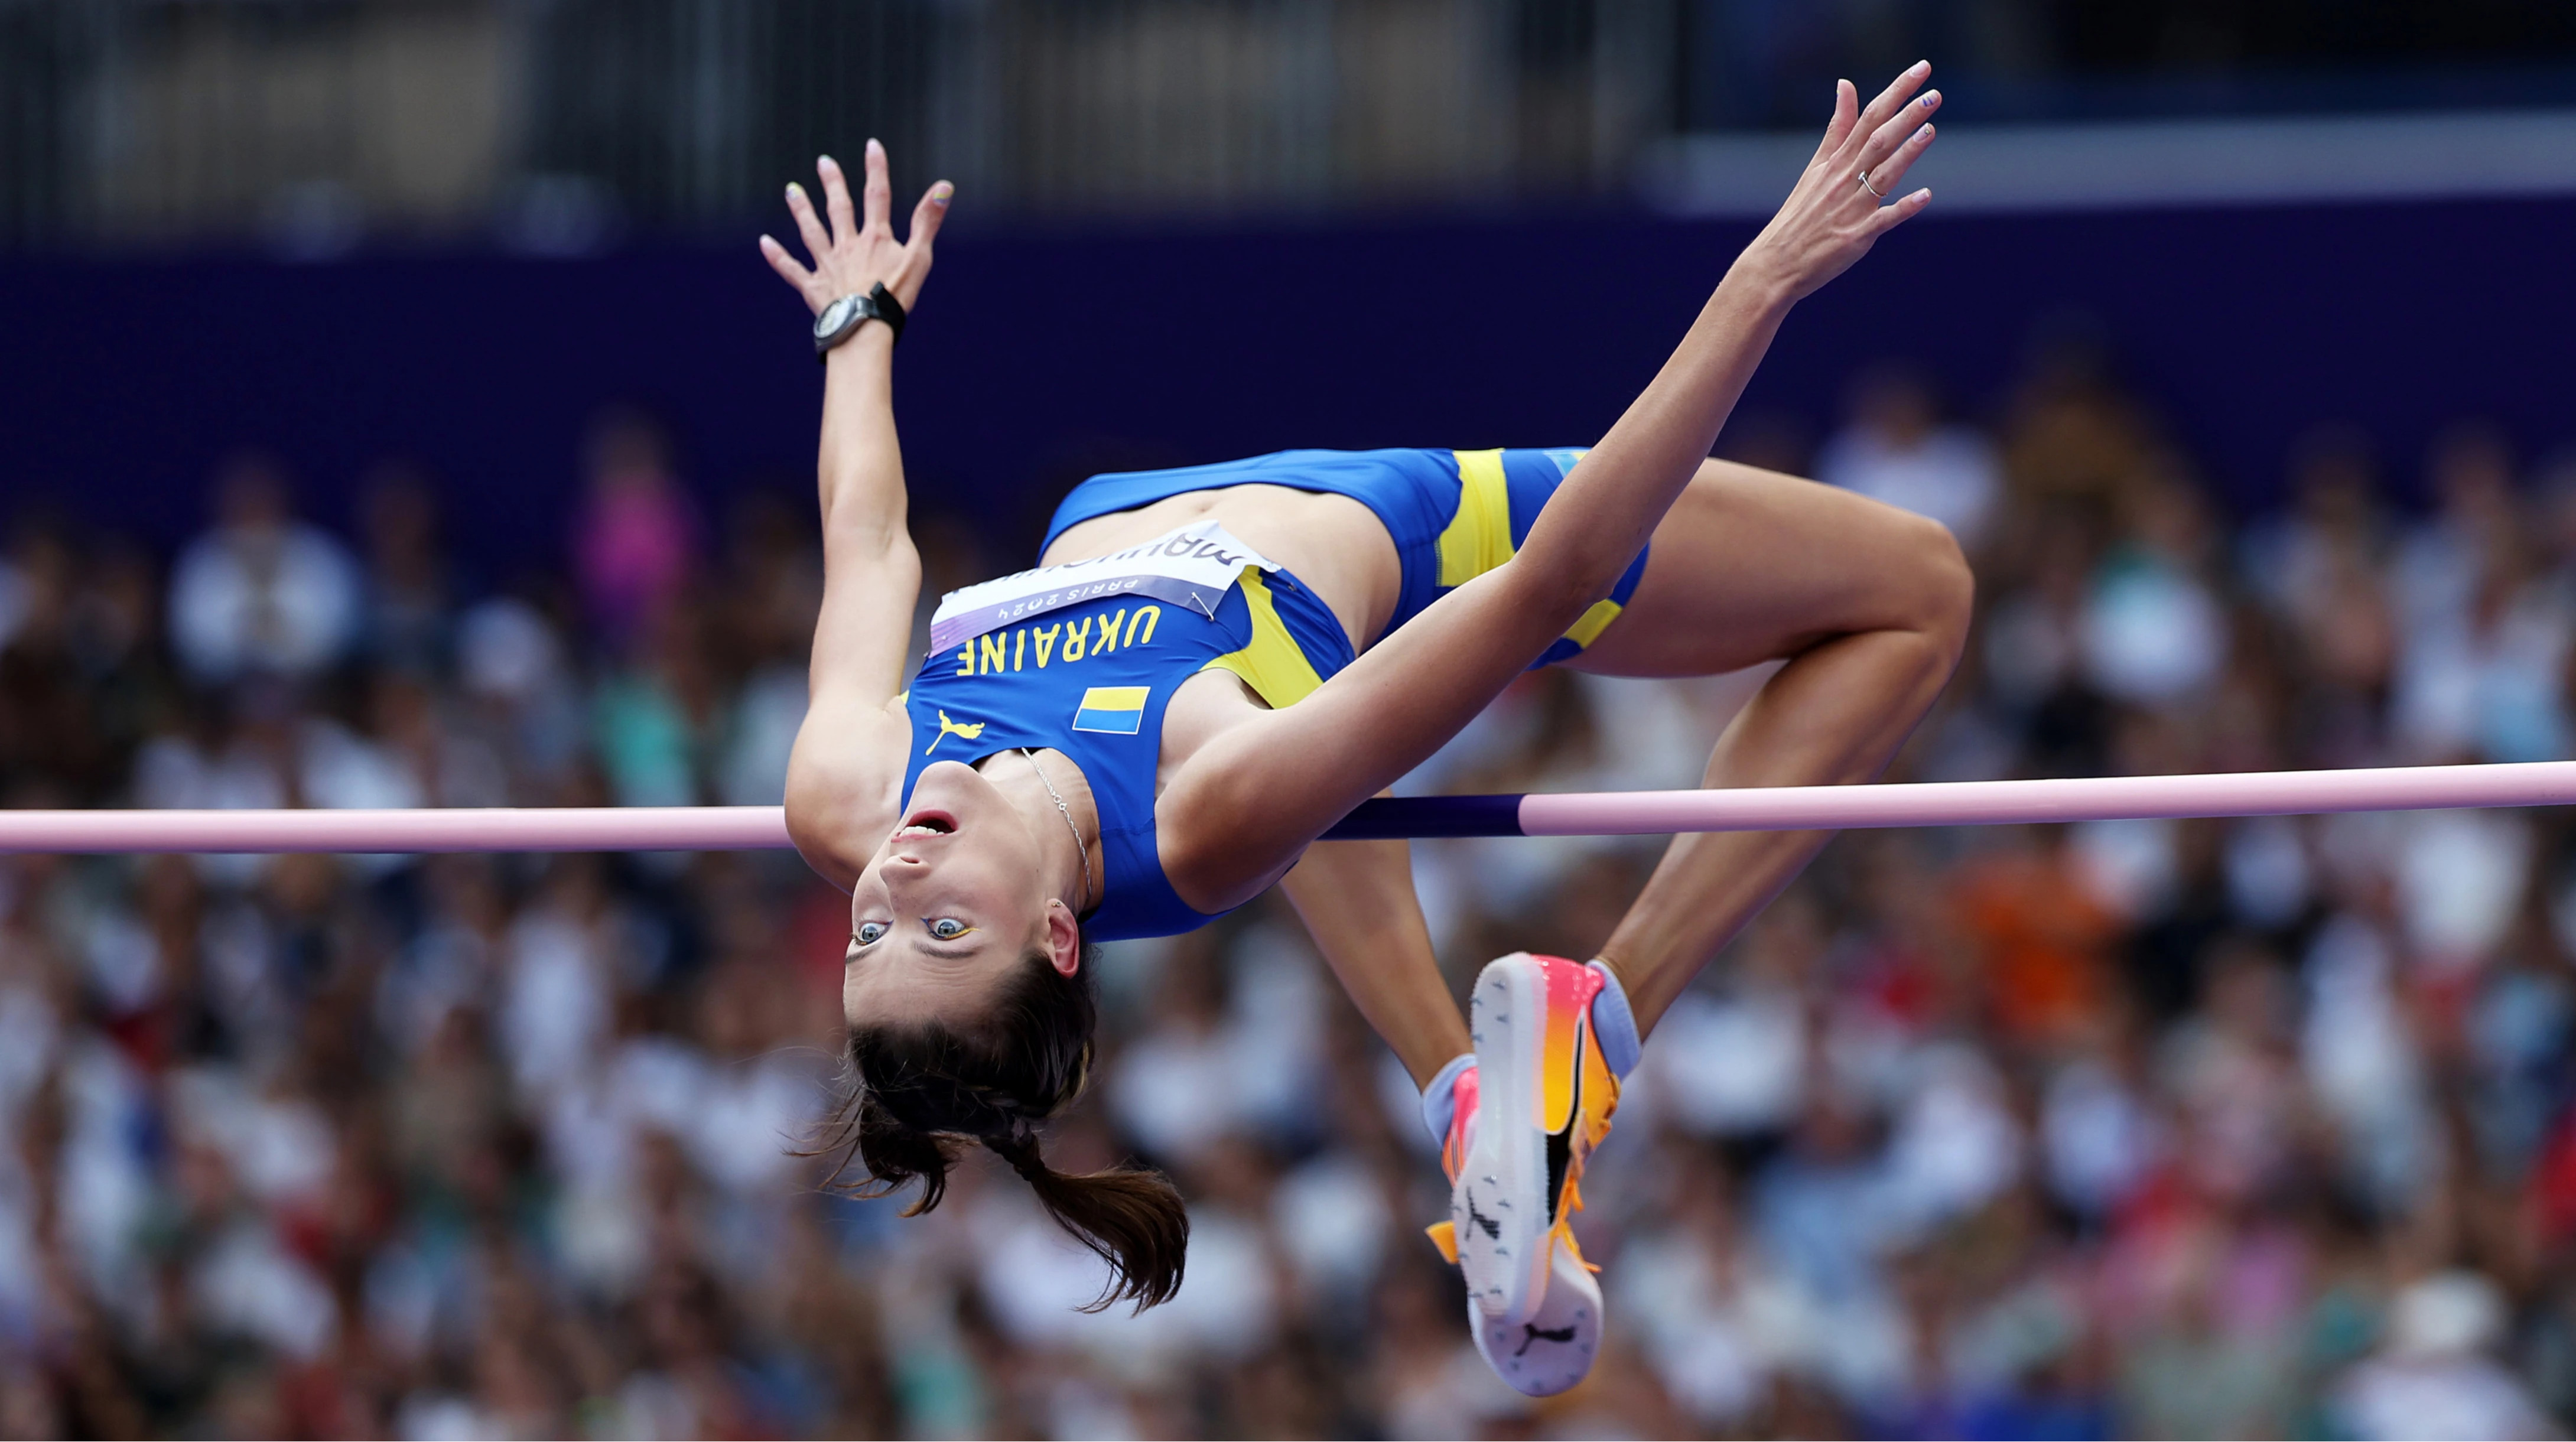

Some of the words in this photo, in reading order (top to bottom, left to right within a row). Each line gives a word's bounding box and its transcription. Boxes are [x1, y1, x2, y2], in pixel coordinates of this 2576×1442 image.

[1066, 578, 1139, 600] PARIS
[998, 593, 1059, 620] 2024
[956, 605, 1162, 676] UKRAINE
